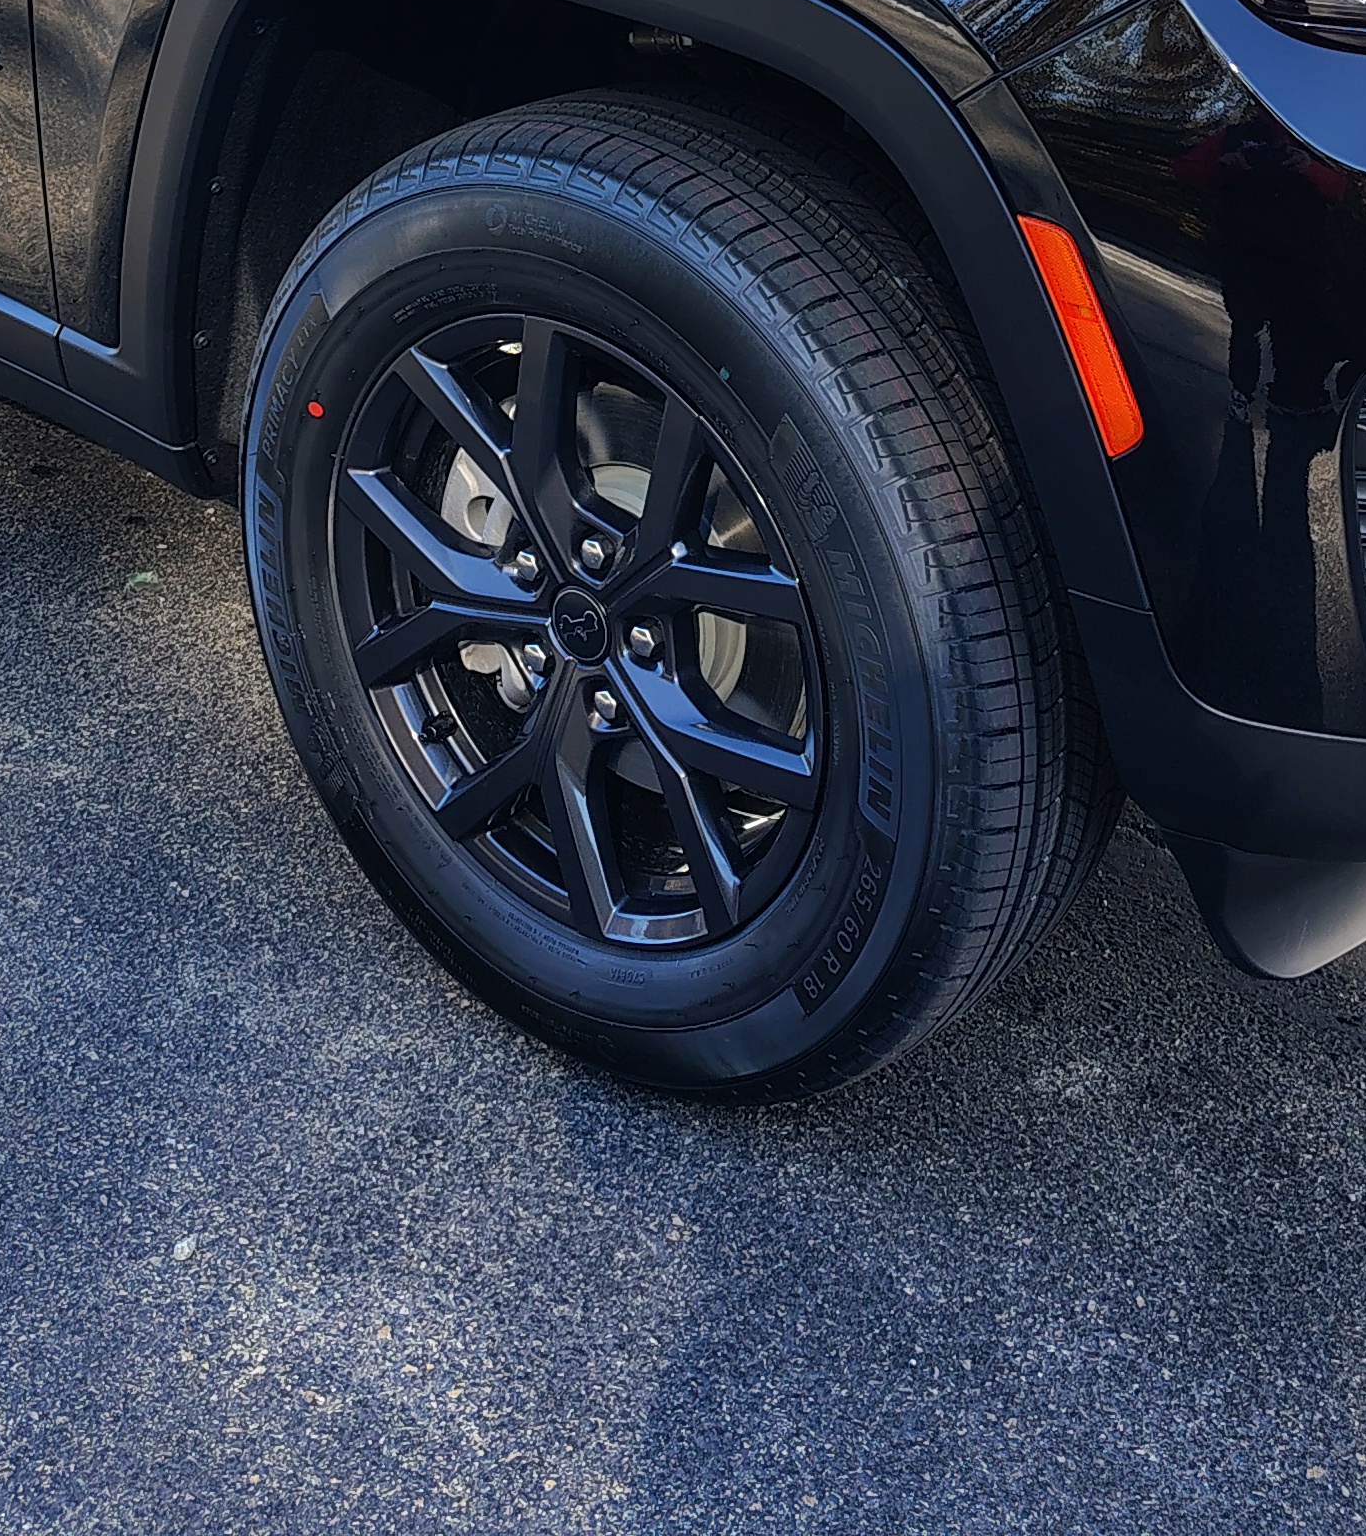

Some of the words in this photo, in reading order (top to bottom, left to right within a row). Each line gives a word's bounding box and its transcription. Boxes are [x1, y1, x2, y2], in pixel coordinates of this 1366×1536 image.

[262, 347, 300, 461] PRIMACY
[257, 488, 311, 715] MICHELIN
[825, 549, 893, 823] MICHELIN
[836, 854, 882, 953] 265/60
[802, 970, 826, 999] 18
[822, 948, 841, 975] R
